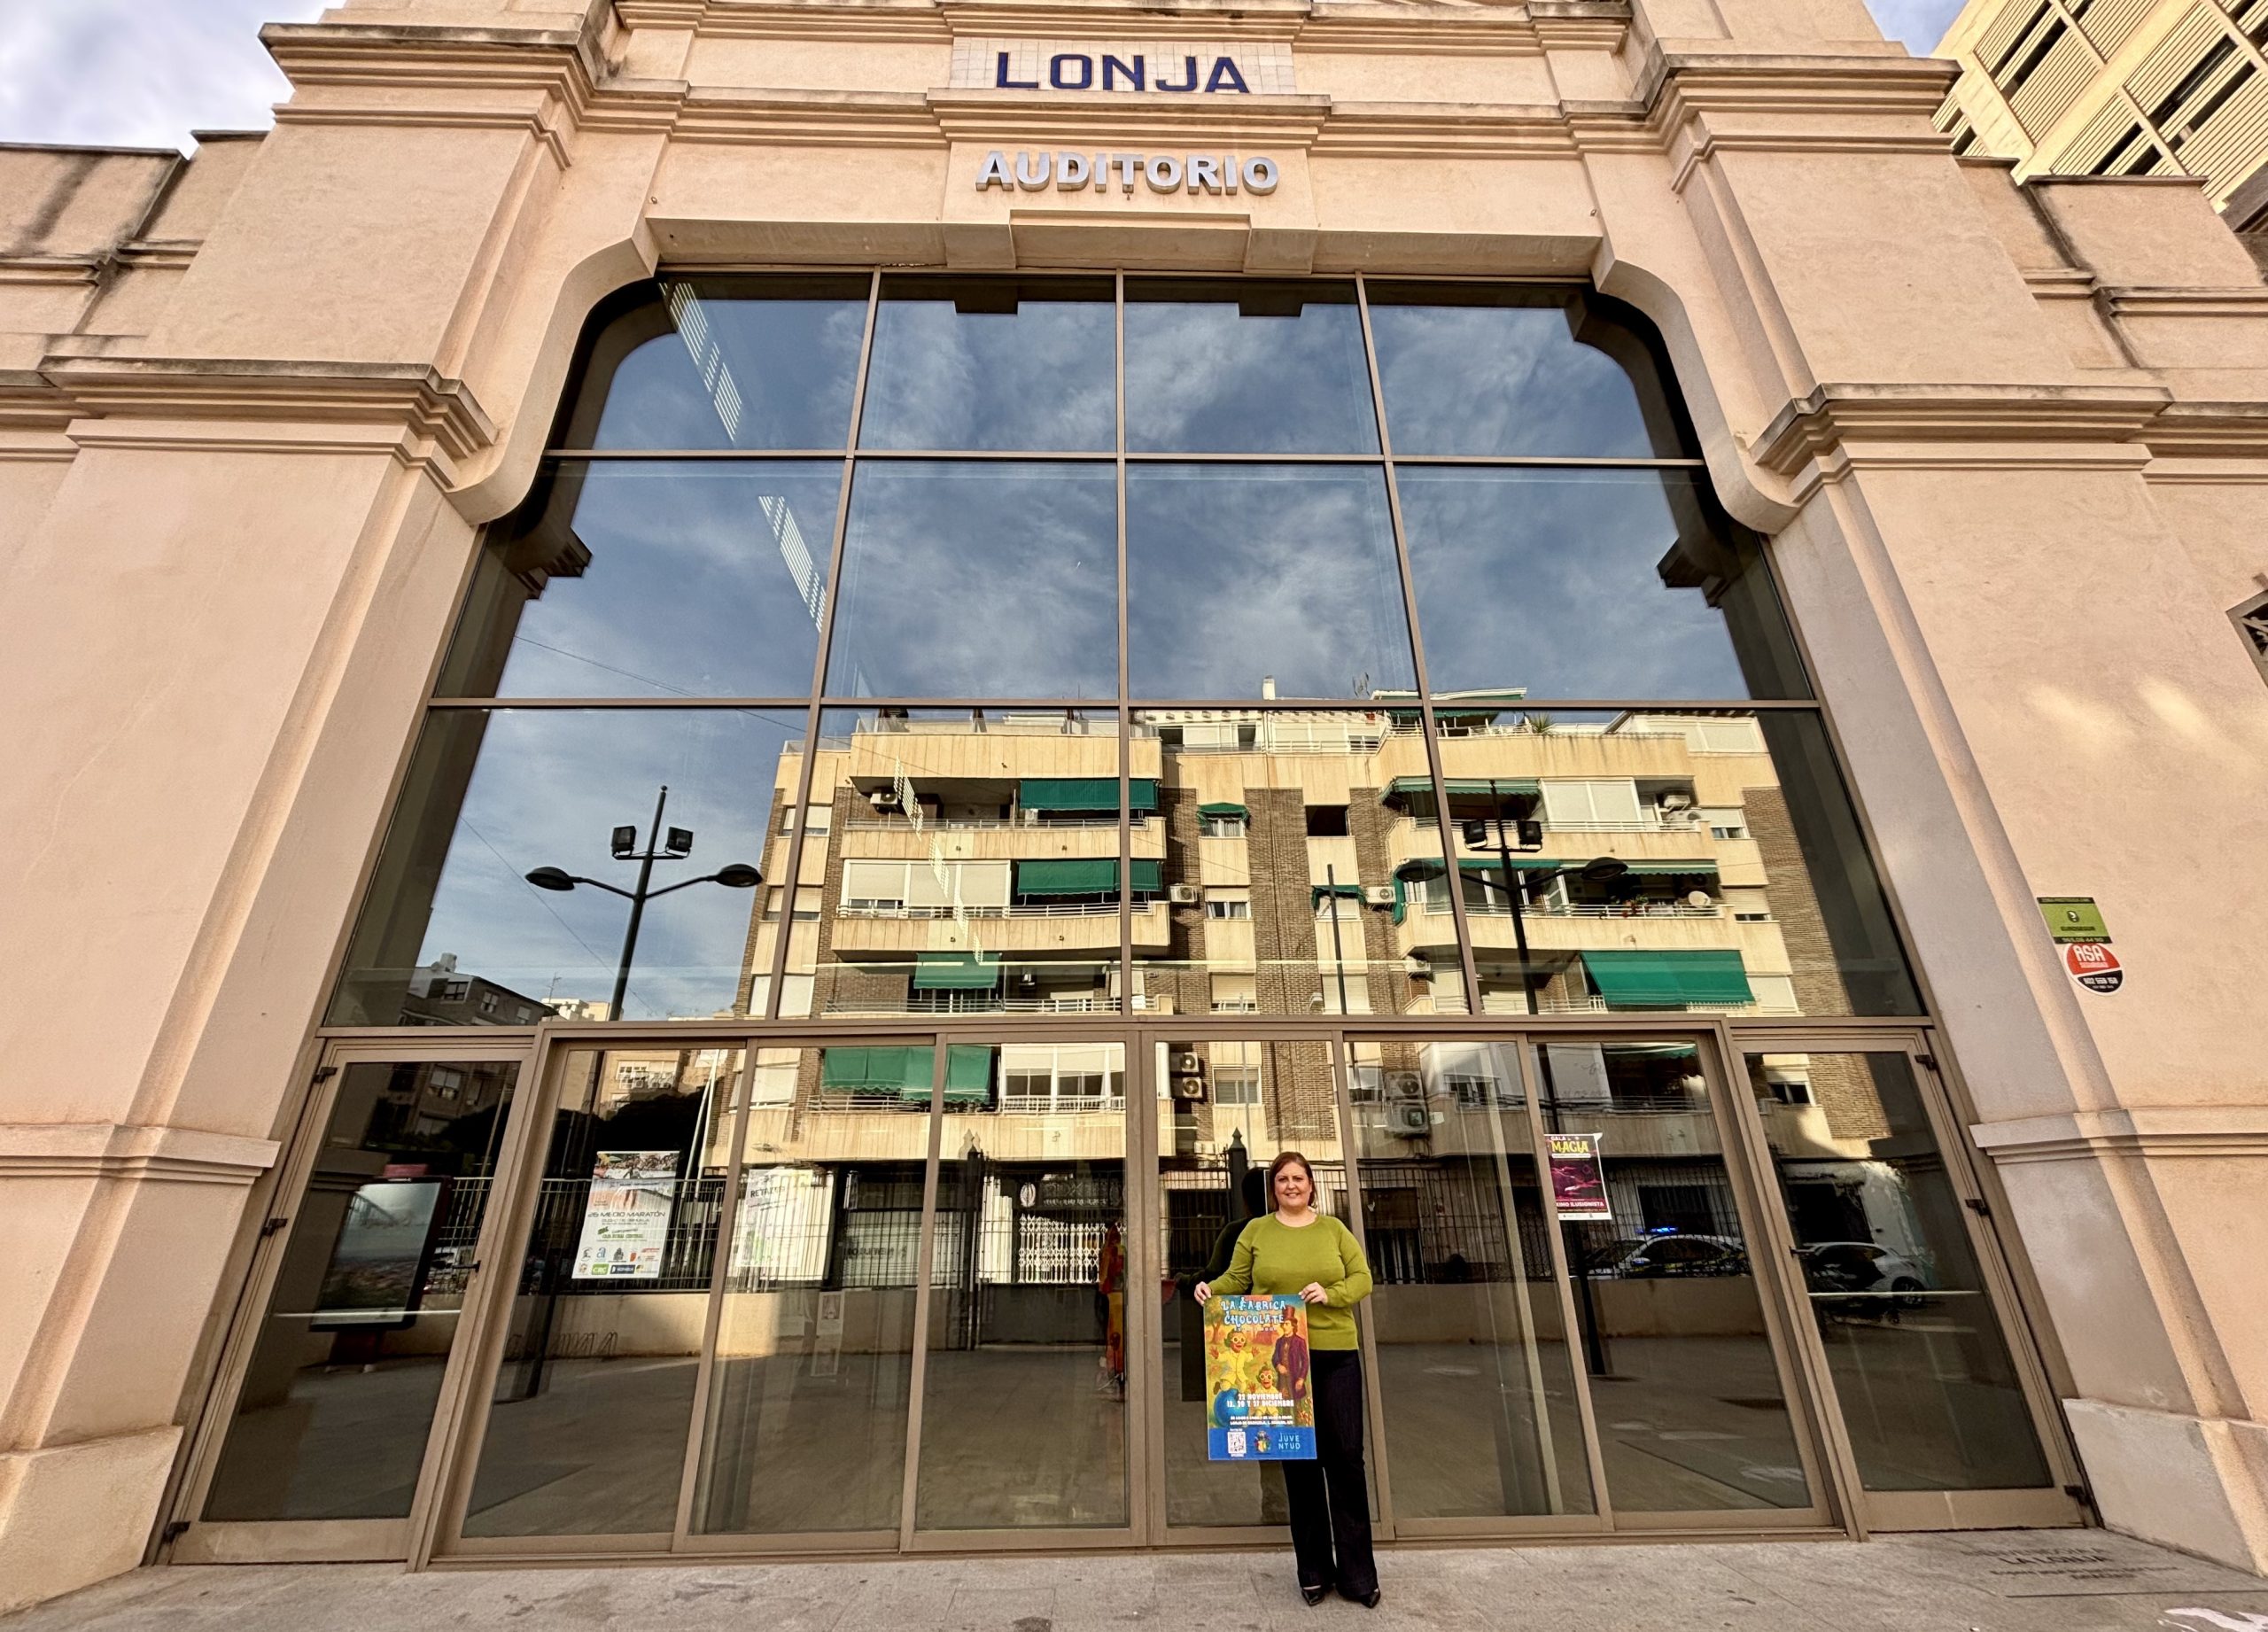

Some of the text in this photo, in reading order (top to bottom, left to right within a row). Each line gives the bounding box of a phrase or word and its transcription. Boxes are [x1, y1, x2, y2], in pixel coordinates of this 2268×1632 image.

[996, 51, 1251, 93] LONJA
[975, 151, 1278, 196] AUDITORIO
[2073, 944, 2106, 961] ASA
[1551, 1140, 1588, 1153] MAGIA
[1221, 1297, 1286, 1310] LA FABRICA
[1223, 1311, 1285, 1326] CHOCOLATE
[1278, 1433, 1300, 1442] JUVE
